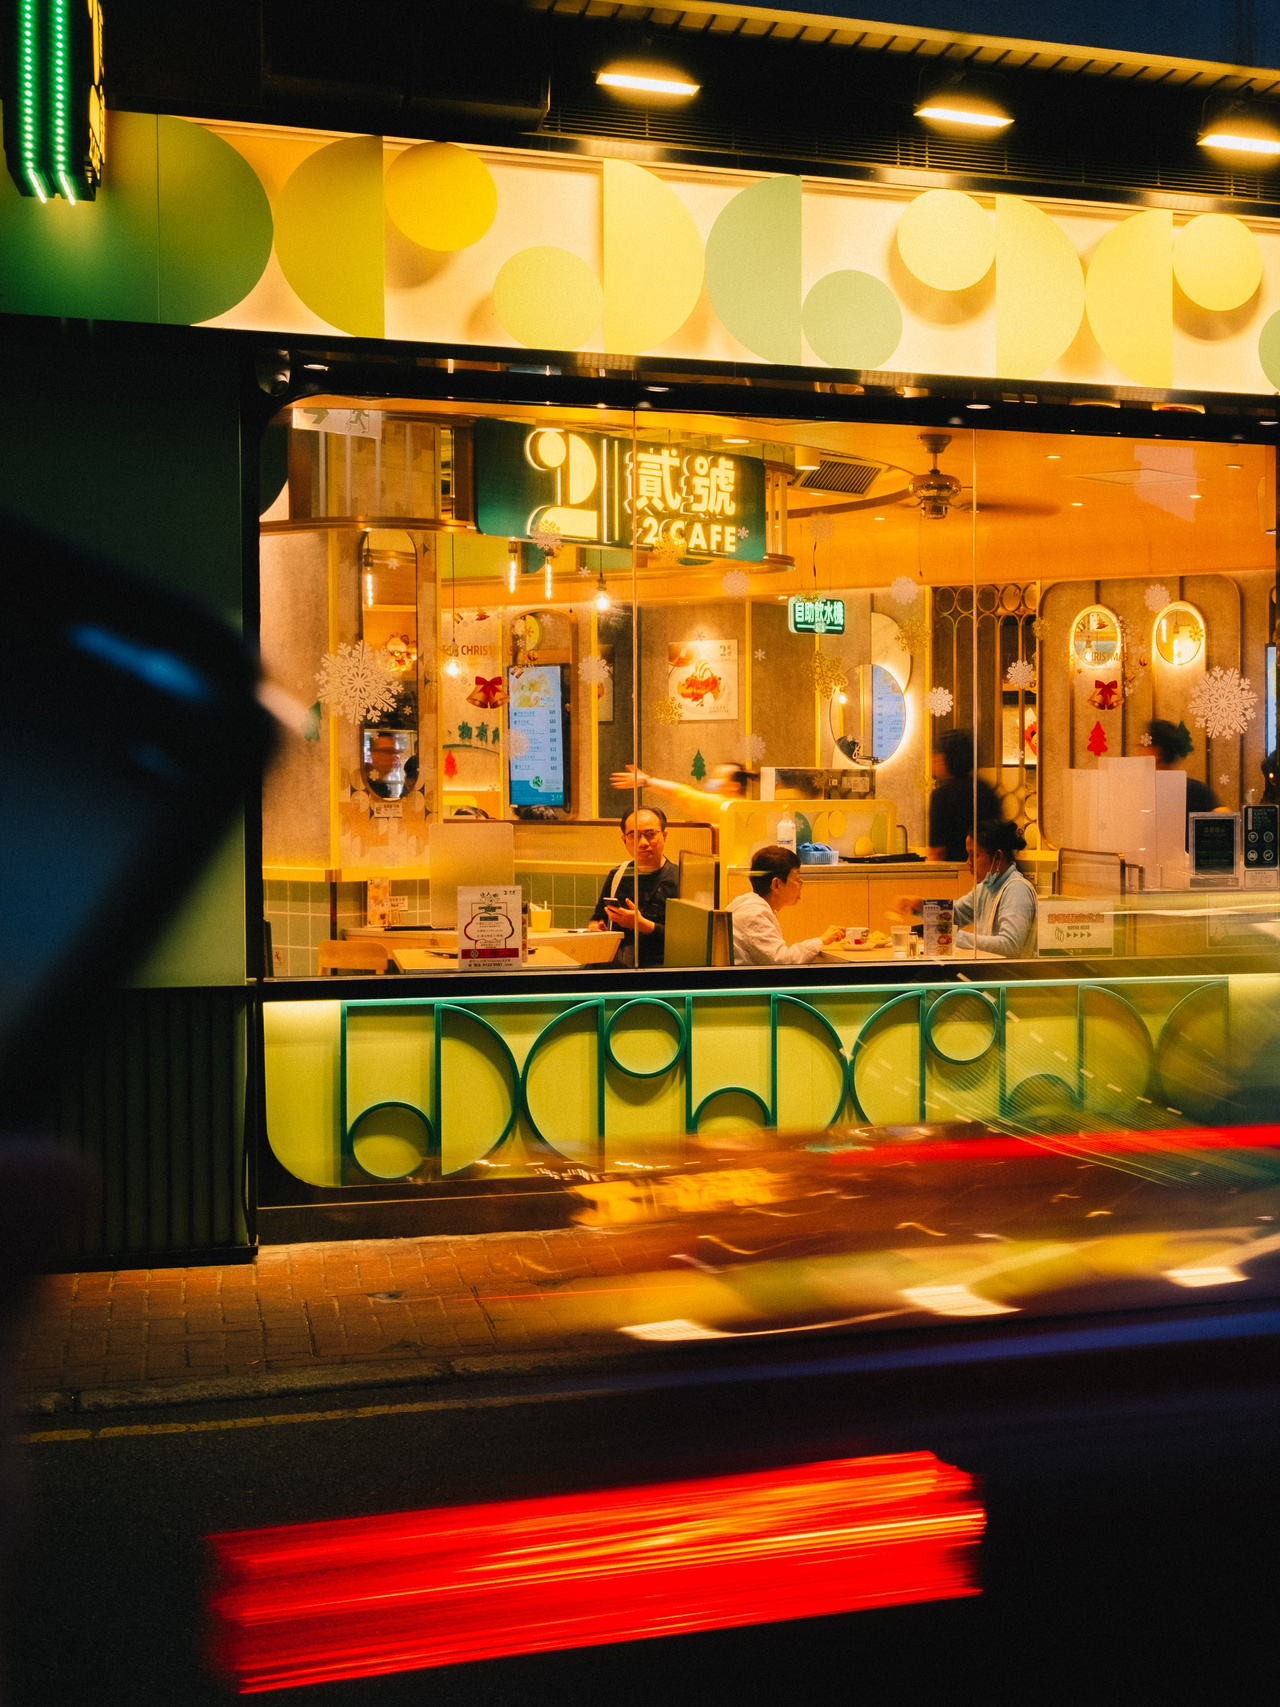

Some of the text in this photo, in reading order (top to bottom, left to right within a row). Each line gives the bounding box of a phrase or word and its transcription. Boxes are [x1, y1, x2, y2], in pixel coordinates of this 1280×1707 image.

[633, 448, 737, 516] 貳號
[643, 516, 737, 553] 2 CAFE
[795, 601, 843, 625] 自助飲水機
